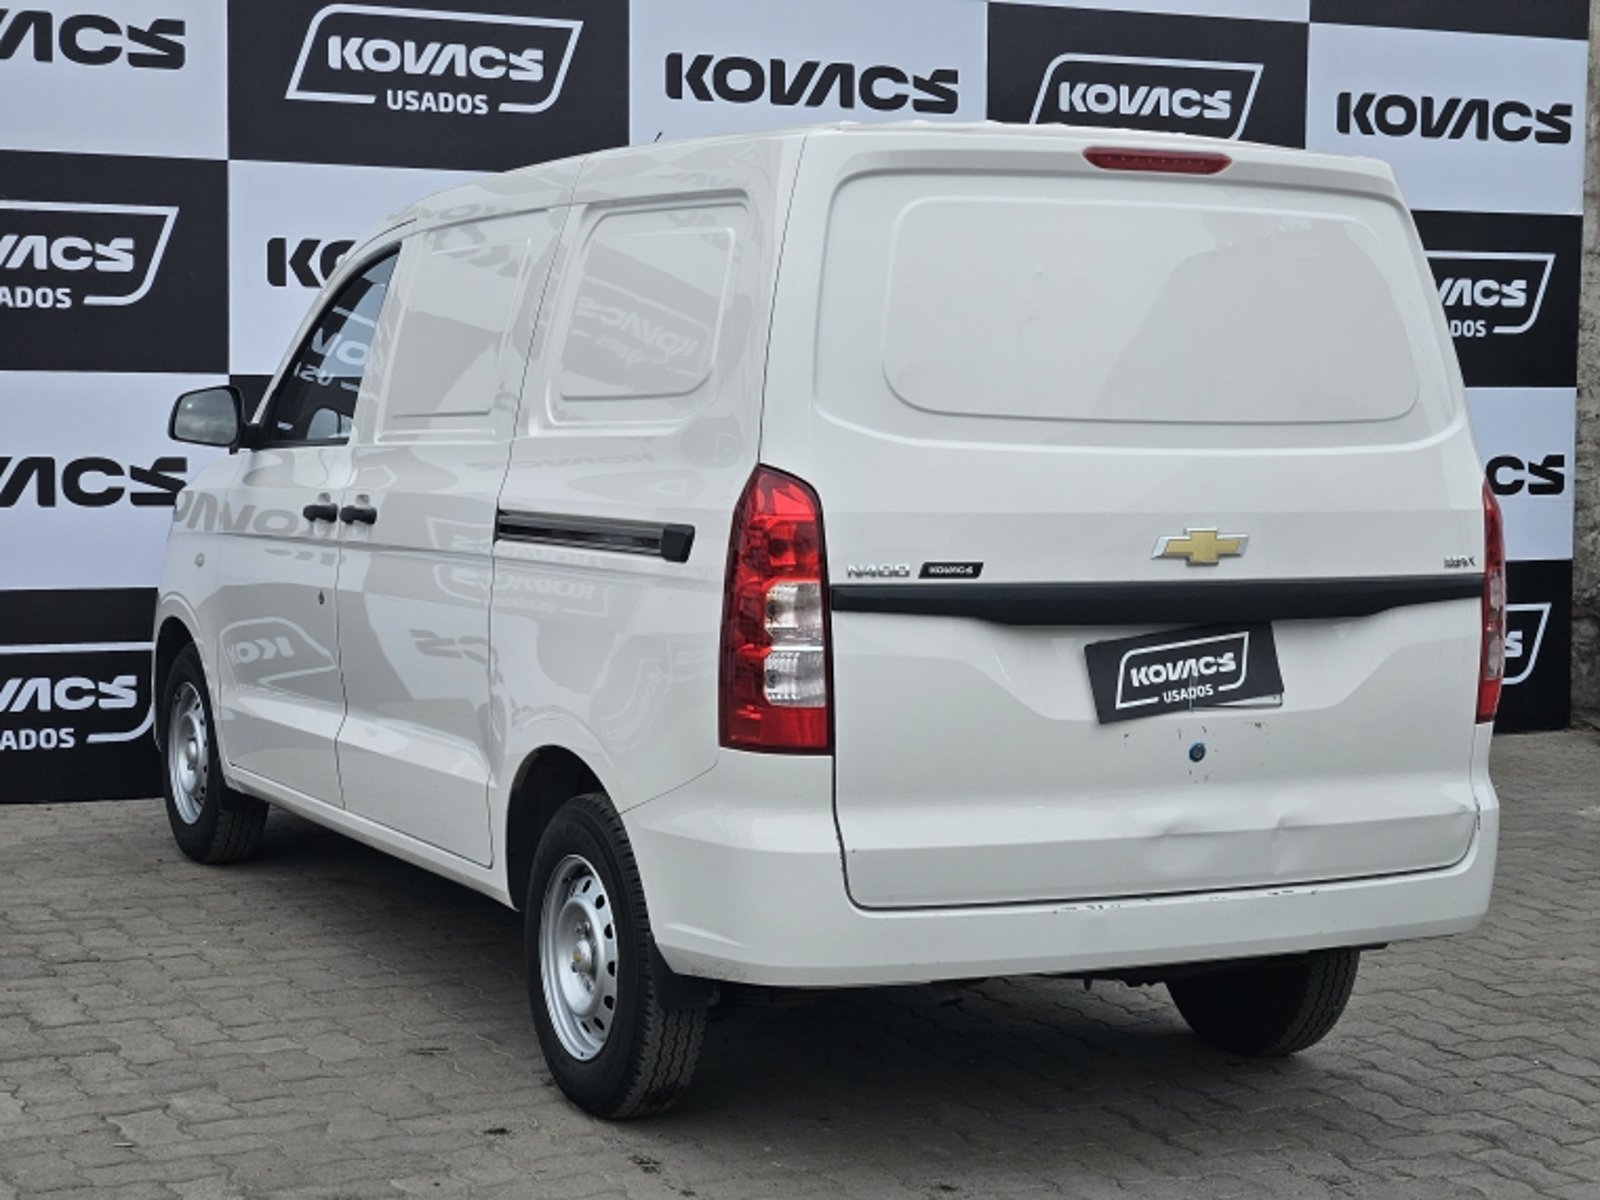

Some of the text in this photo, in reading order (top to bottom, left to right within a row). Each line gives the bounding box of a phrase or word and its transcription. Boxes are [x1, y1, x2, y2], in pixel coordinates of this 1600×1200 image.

[0, 8, 186, 70] ACS
[328, 35, 545, 82] KOVACS
[386, 89, 489, 115] USADOS
[665, 52, 959, 115] KOVACS
[1058, 81, 1232, 120] KOVACS
[1336, 91, 1573, 145] KOVACS
[847, 562, 911, 579] N400
[1130, 652, 1236, 687] KOVACS
[1162, 684, 1214, 704] USADOS
